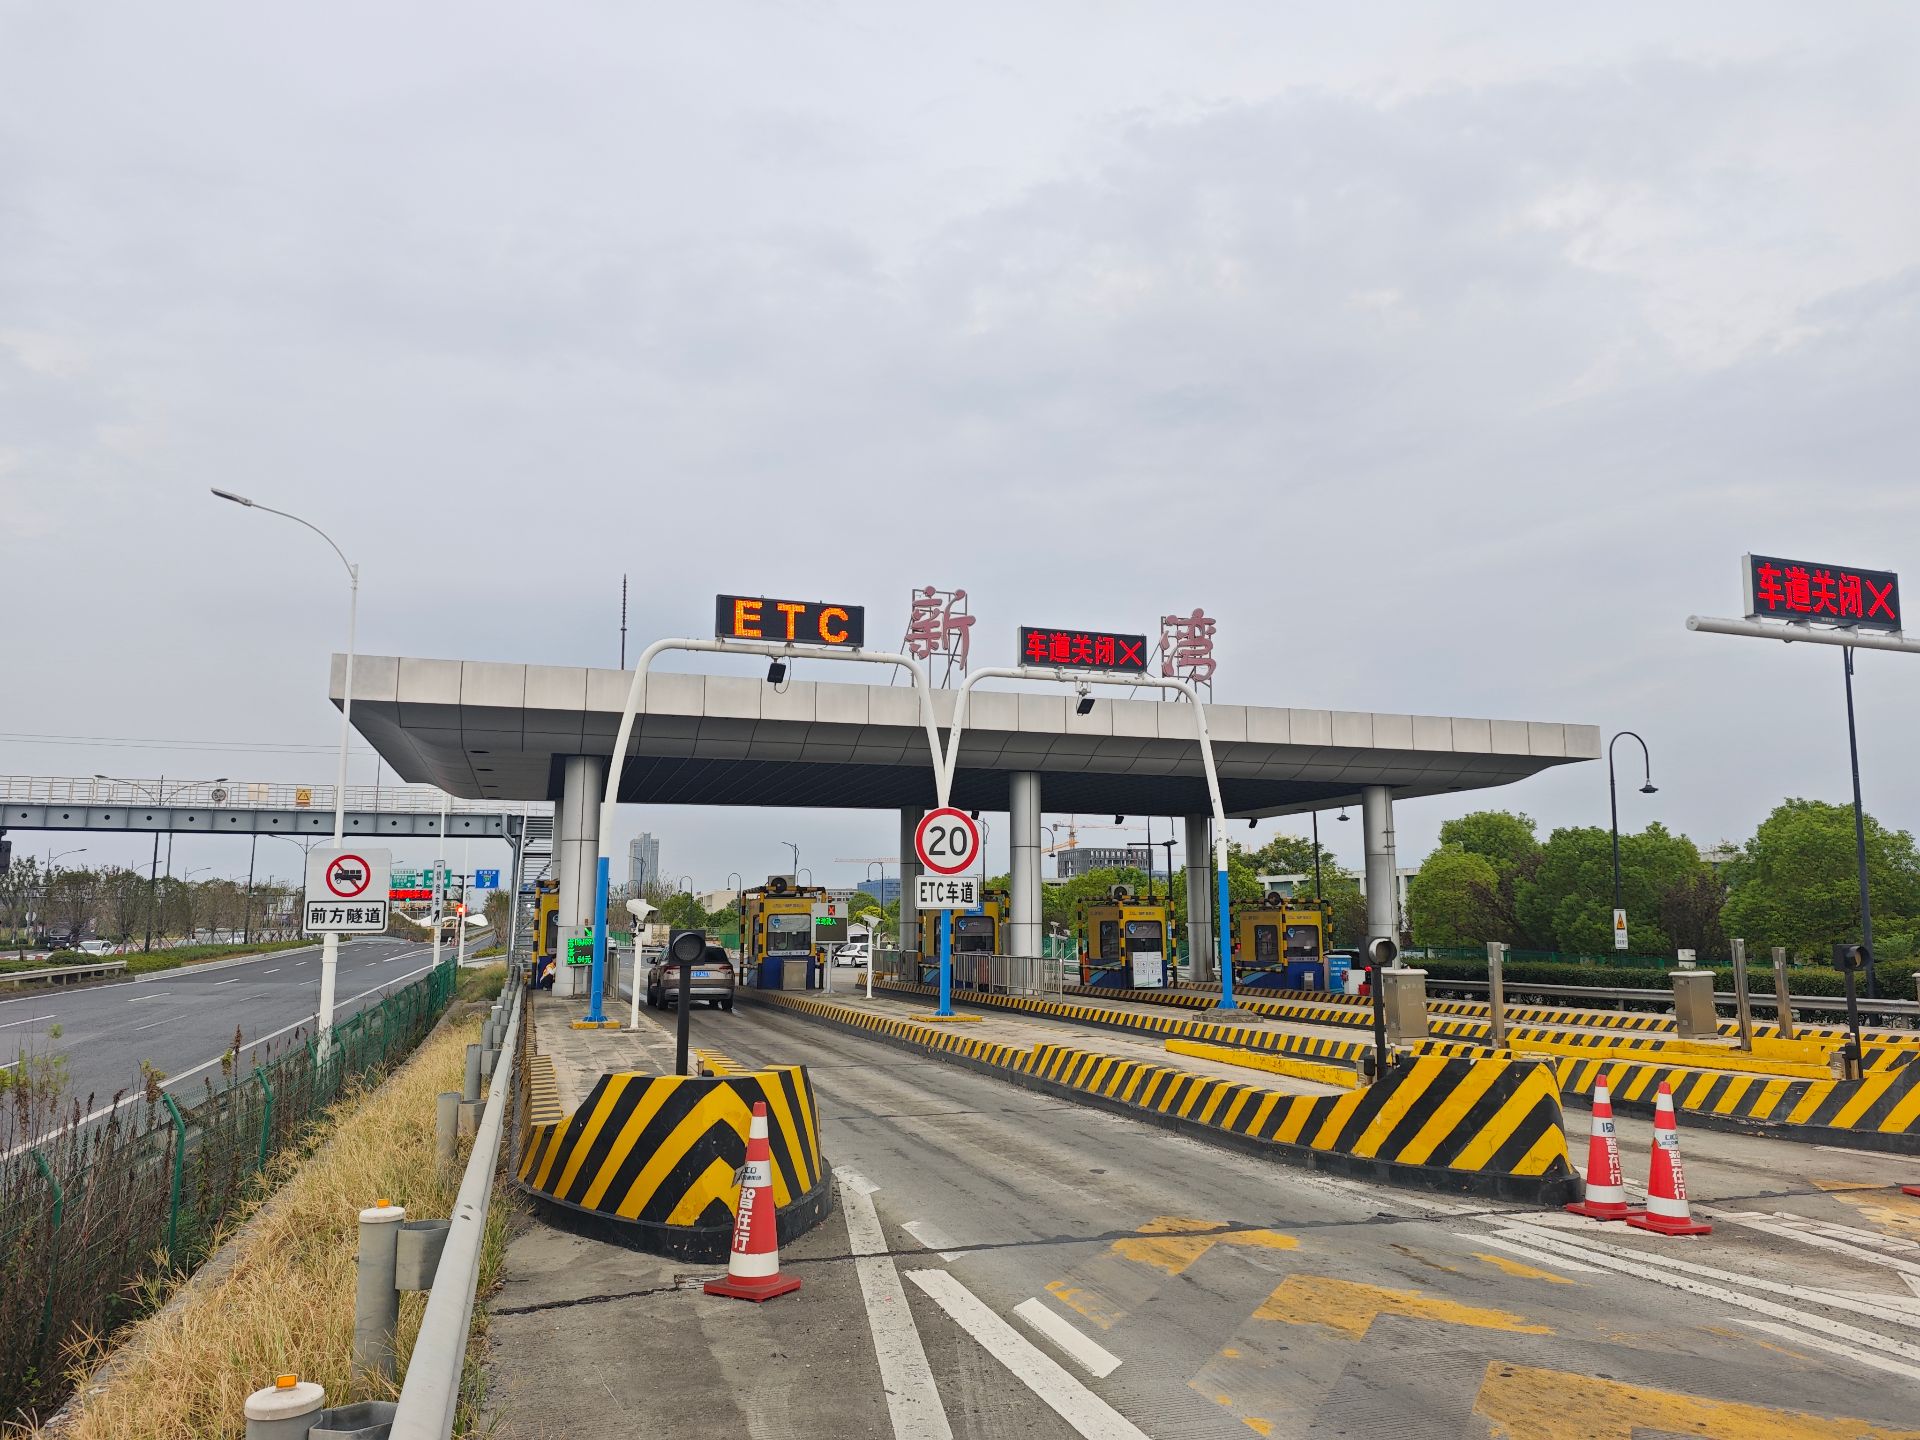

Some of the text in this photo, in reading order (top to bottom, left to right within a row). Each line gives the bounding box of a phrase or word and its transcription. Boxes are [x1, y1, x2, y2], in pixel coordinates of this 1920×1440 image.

[1757, 562, 1863, 618] 车道关闭
[733, 598, 850, 643] ETC
[905, 586, 976, 671] 新
[1025, 630, 1115, 666] 车道关闭
[928, 826, 968, 857] 20
[920, 881, 974, 904] ETC车道
[310, 907, 382, 925] 前方隧道
[1668, 1150, 1687, 1200] 智在行
[733, 1187, 756, 1252] 智在行
